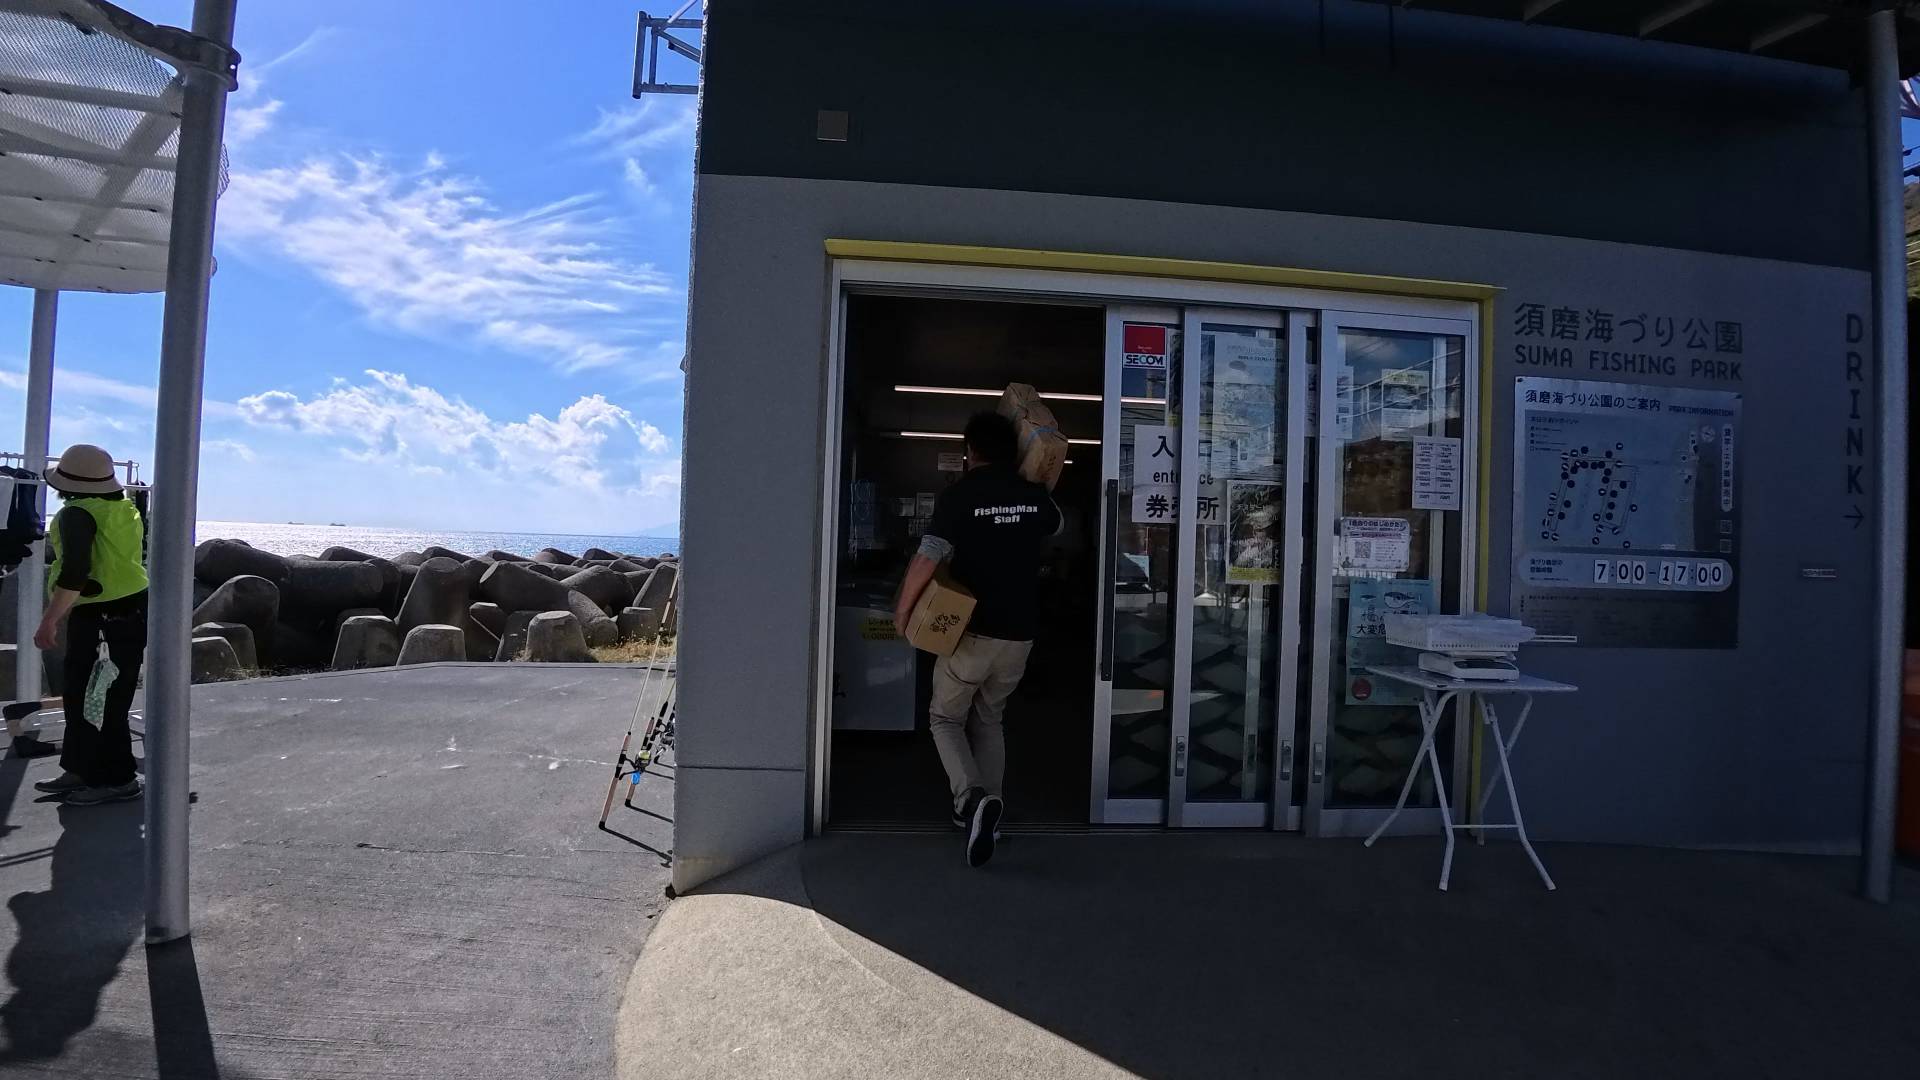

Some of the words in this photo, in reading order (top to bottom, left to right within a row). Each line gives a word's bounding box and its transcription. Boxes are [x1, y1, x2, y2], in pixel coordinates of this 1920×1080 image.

[1515, 302, 1743, 354] 須磨海づり公園
[1126, 354, 1163, 366] SECOM
[1515, 344, 1573, 368] SUMA
[1590, 350, 1676, 376] FISHING
[1691, 358, 1743, 381] PARK
[1525, 389, 1661, 412] 須磨海づり公園のご案内
[1846, 313, 1863, 494] DRINK
[974, 505, 1038, 517] FishingMax
[994, 514, 1020, 524] Staff
